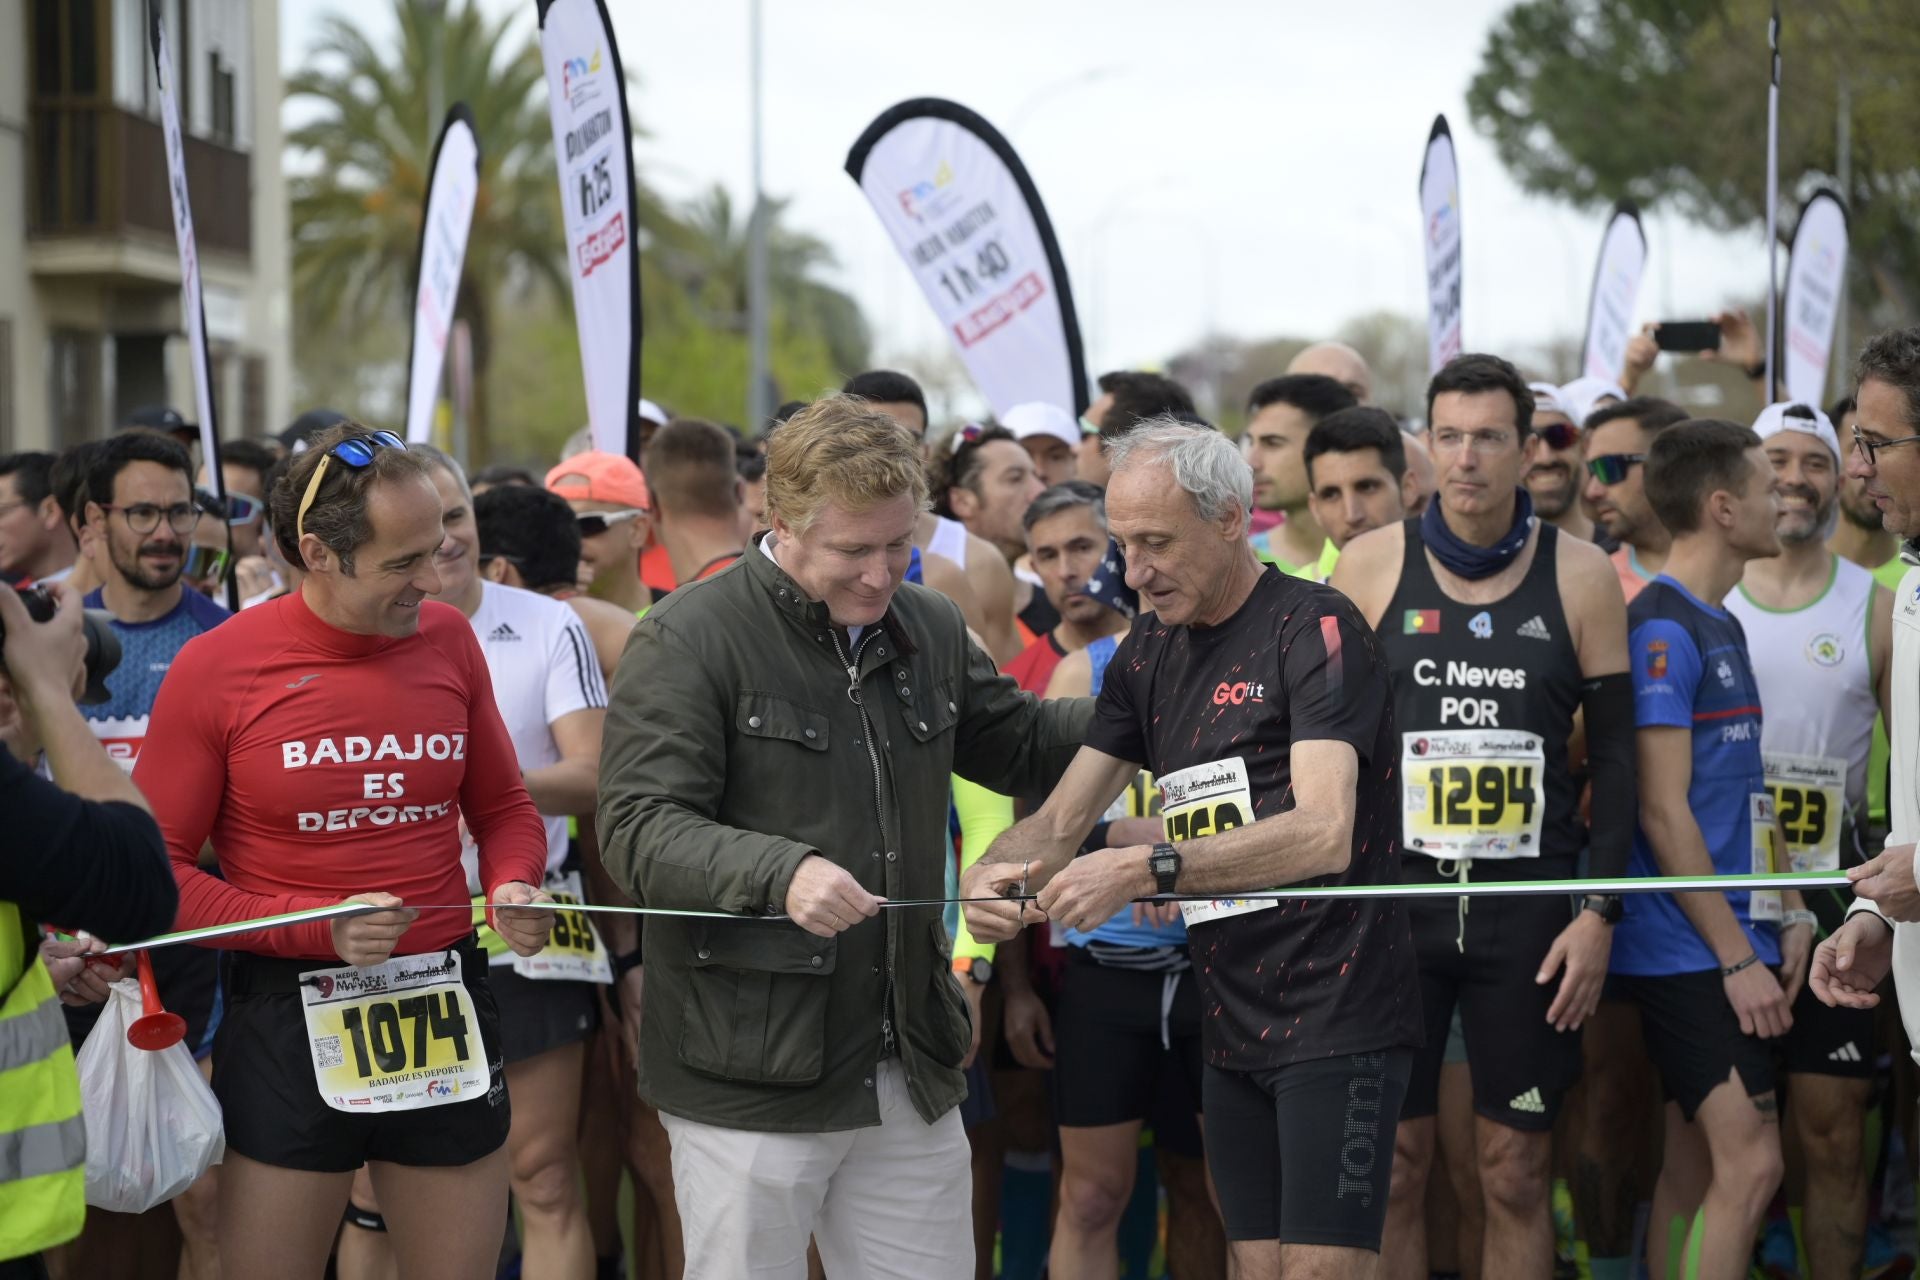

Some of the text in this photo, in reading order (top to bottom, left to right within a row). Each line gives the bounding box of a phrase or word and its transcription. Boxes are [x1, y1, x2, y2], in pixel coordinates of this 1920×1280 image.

[1413, 658, 1526, 690] C. Neves
[1441, 697, 1499, 728] POR
[282, 734, 464, 769] BADAJOZ
[363, 773, 404, 799] ES
[1429, 766, 1536, 825] 1294
[341, 990, 470, 1079] 1074
[368, 1064, 465, 1089] BADAJOZ ES DEPORTE
